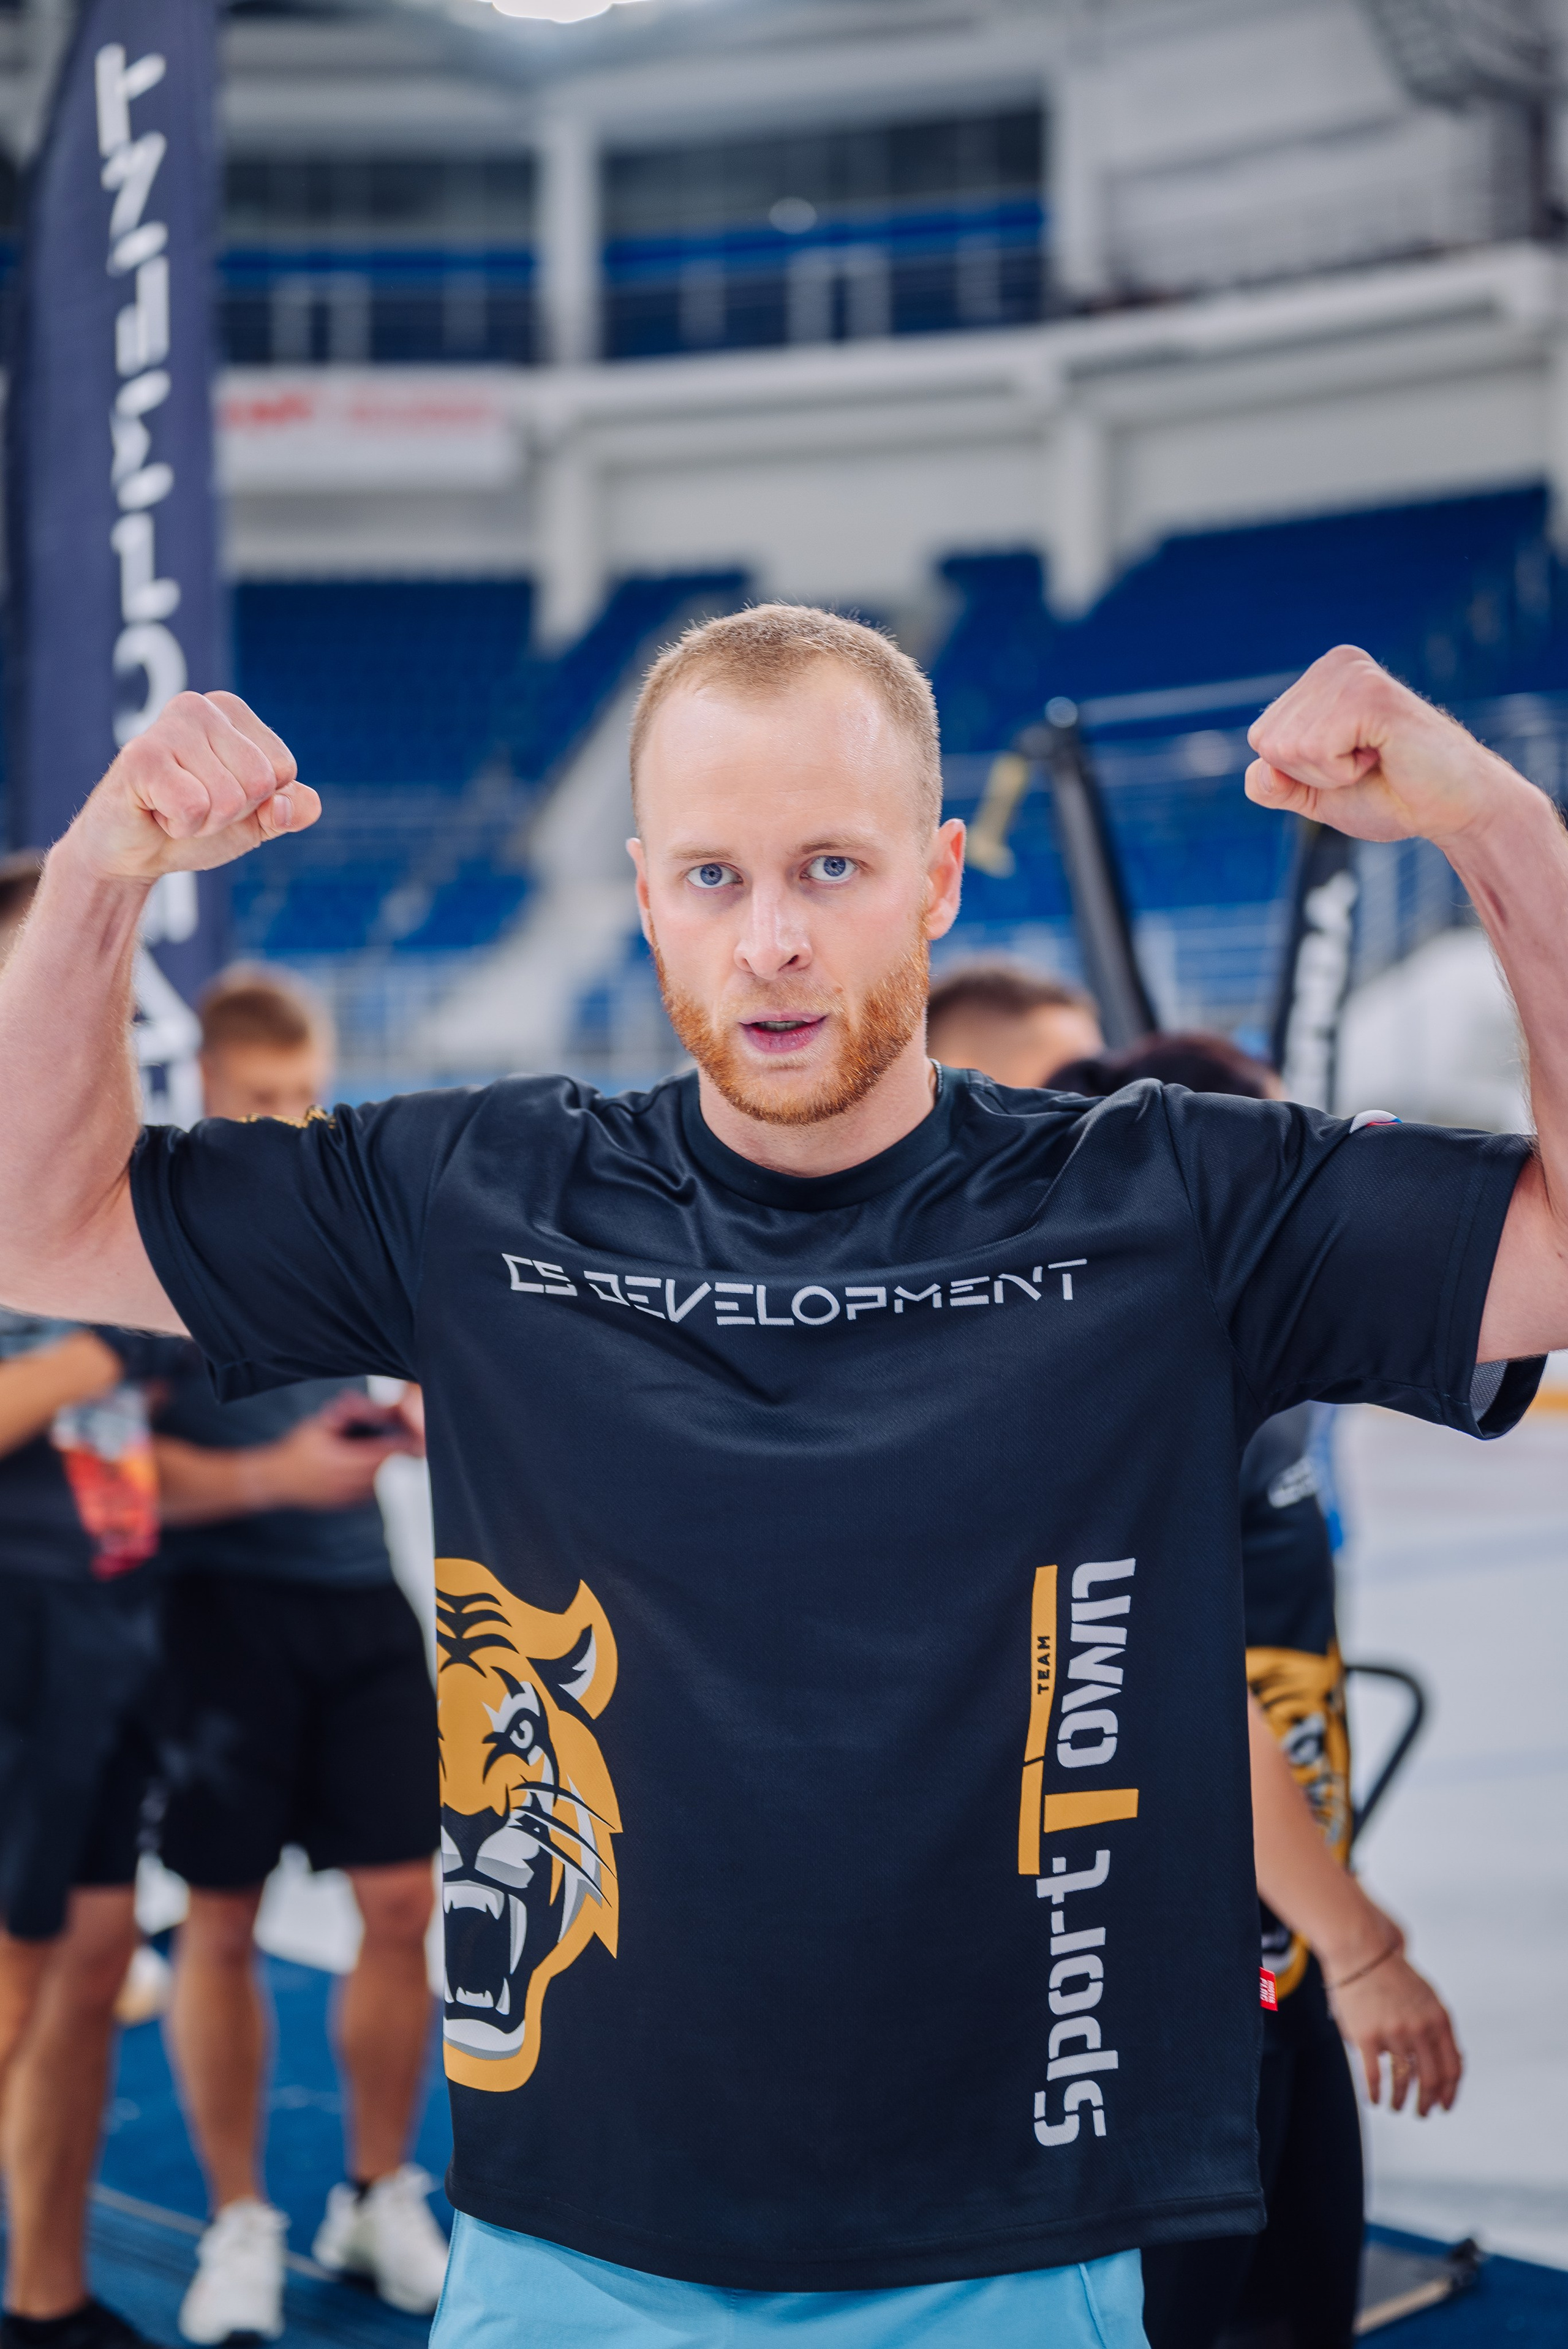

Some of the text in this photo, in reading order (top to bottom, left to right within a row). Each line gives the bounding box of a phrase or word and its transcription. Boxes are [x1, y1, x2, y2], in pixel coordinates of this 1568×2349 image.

[502, 1253, 1087, 1325] CS DEVELOPMENT
[1037, 1635, 1050, 1695] TEAM
[1034, 1849, 1118, 2146] Sport
